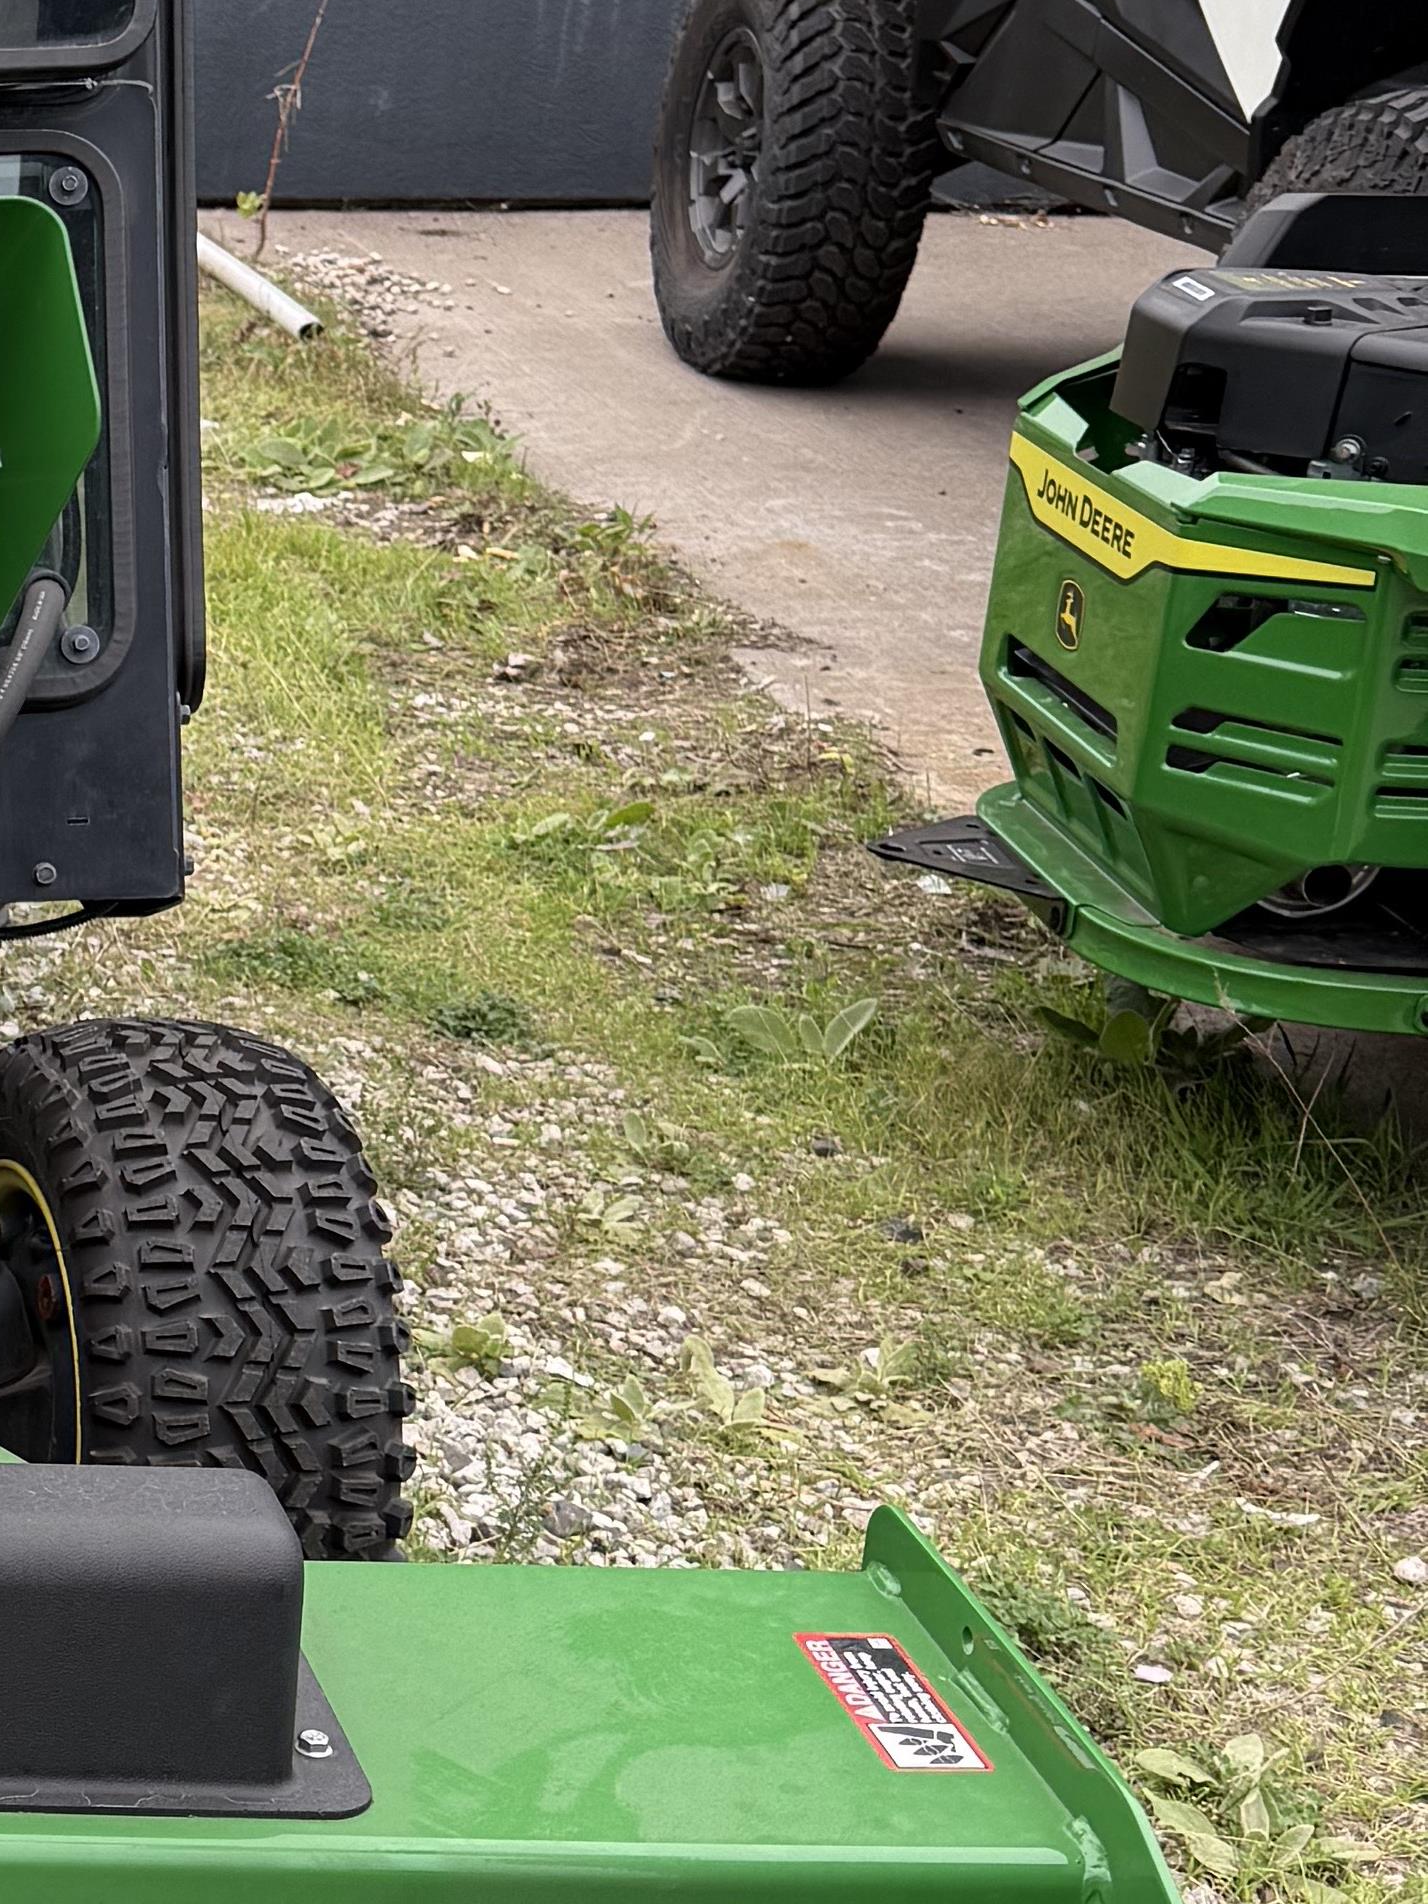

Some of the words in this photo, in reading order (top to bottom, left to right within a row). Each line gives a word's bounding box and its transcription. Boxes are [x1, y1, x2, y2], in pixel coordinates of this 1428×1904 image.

[1037, 469, 1078, 522] JOHN
[1079, 495, 1135, 560] DEERE
[805, 1639, 873, 1706] DANGER
